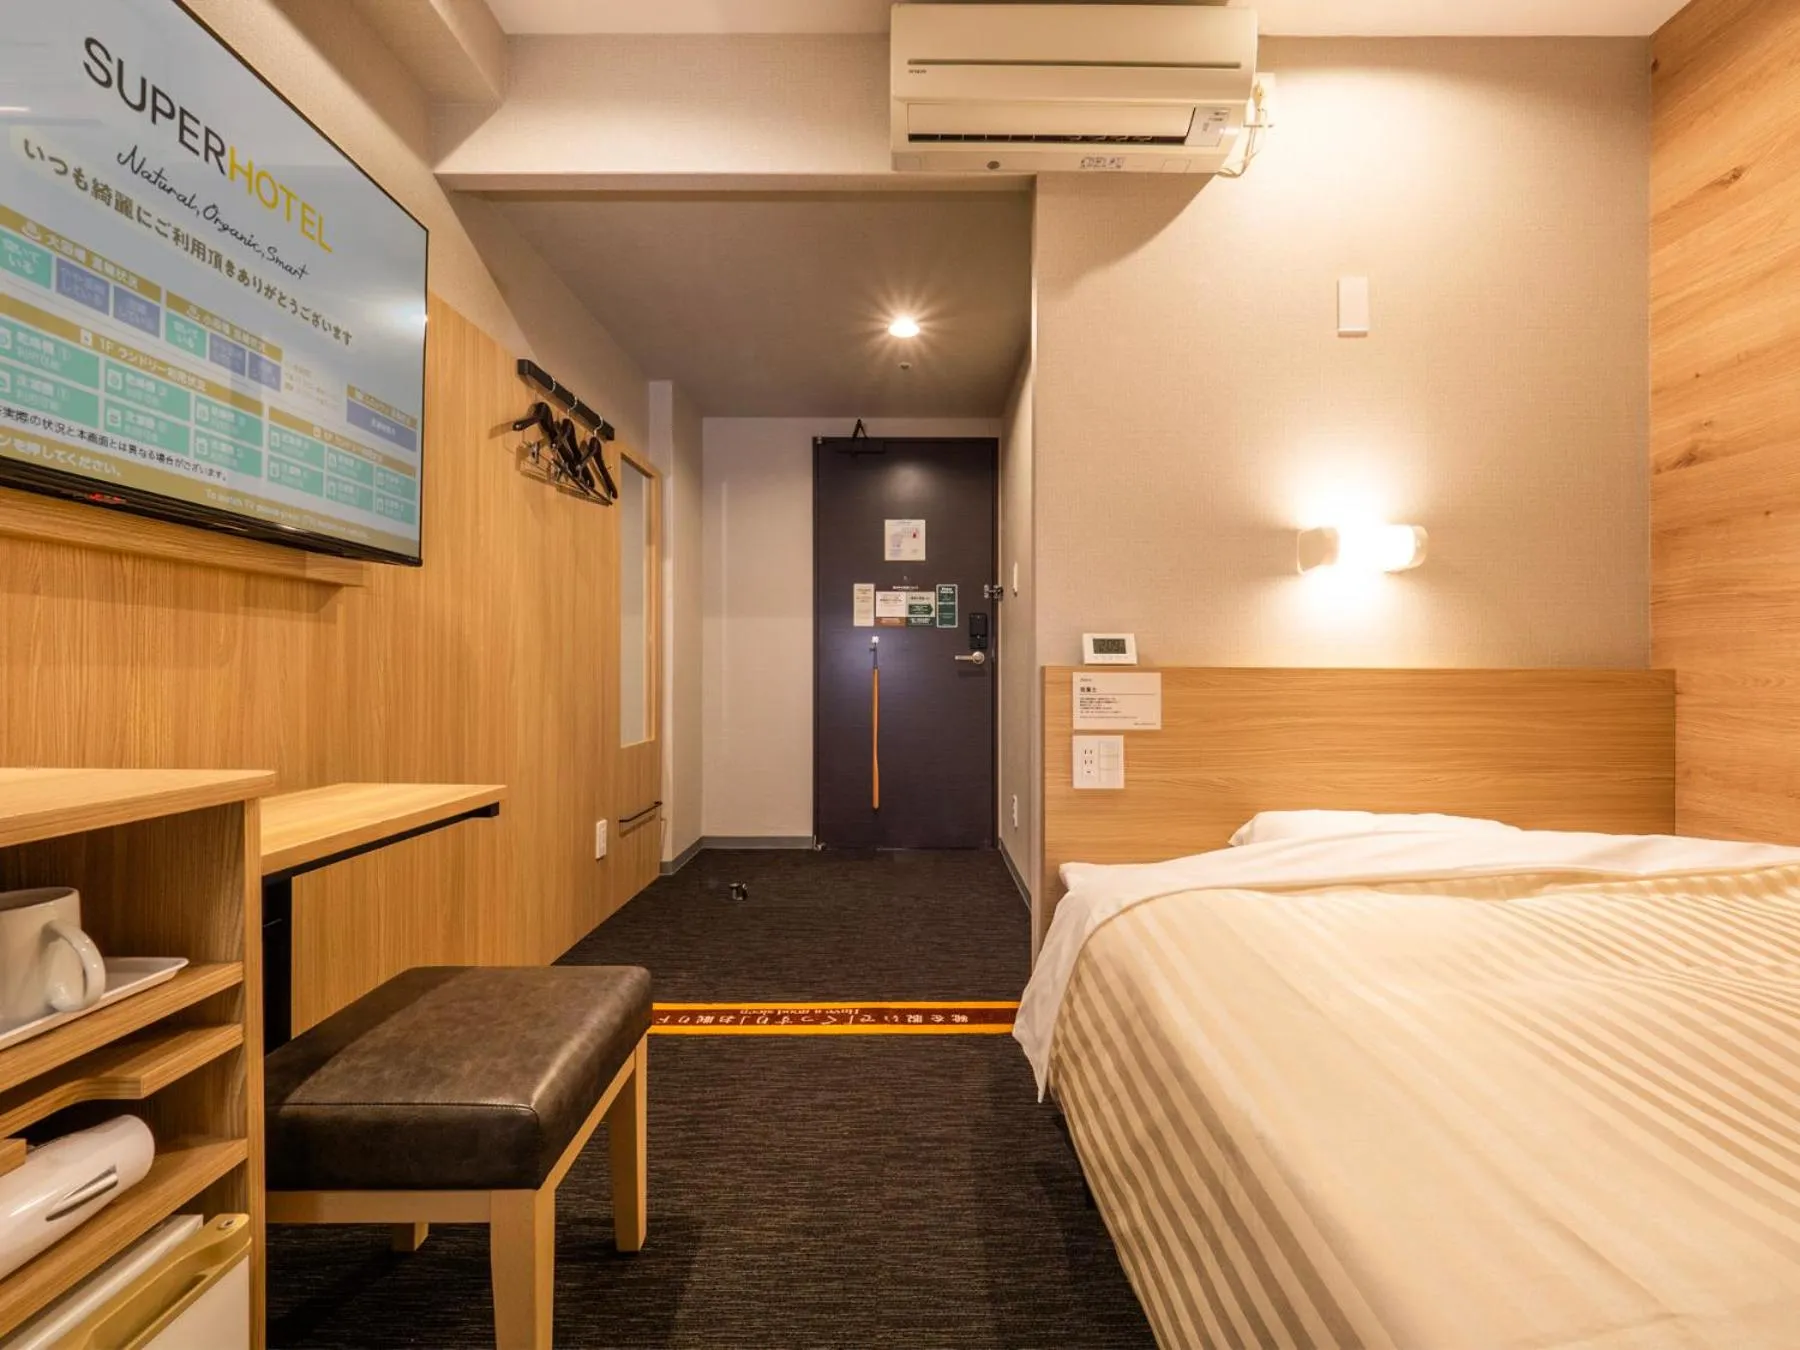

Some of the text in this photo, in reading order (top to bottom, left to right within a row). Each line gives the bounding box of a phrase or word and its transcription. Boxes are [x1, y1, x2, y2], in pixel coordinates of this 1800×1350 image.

[83, 36, 334, 254] SUPERHOTEL
[23, 137, 354, 346] いつも綺麗にご利用頂きありがとうございます
[266, 246, 310, 281] Smart
[0, 405, 227, 481] 実際の状況と本画面とは異なる場合がございます。
